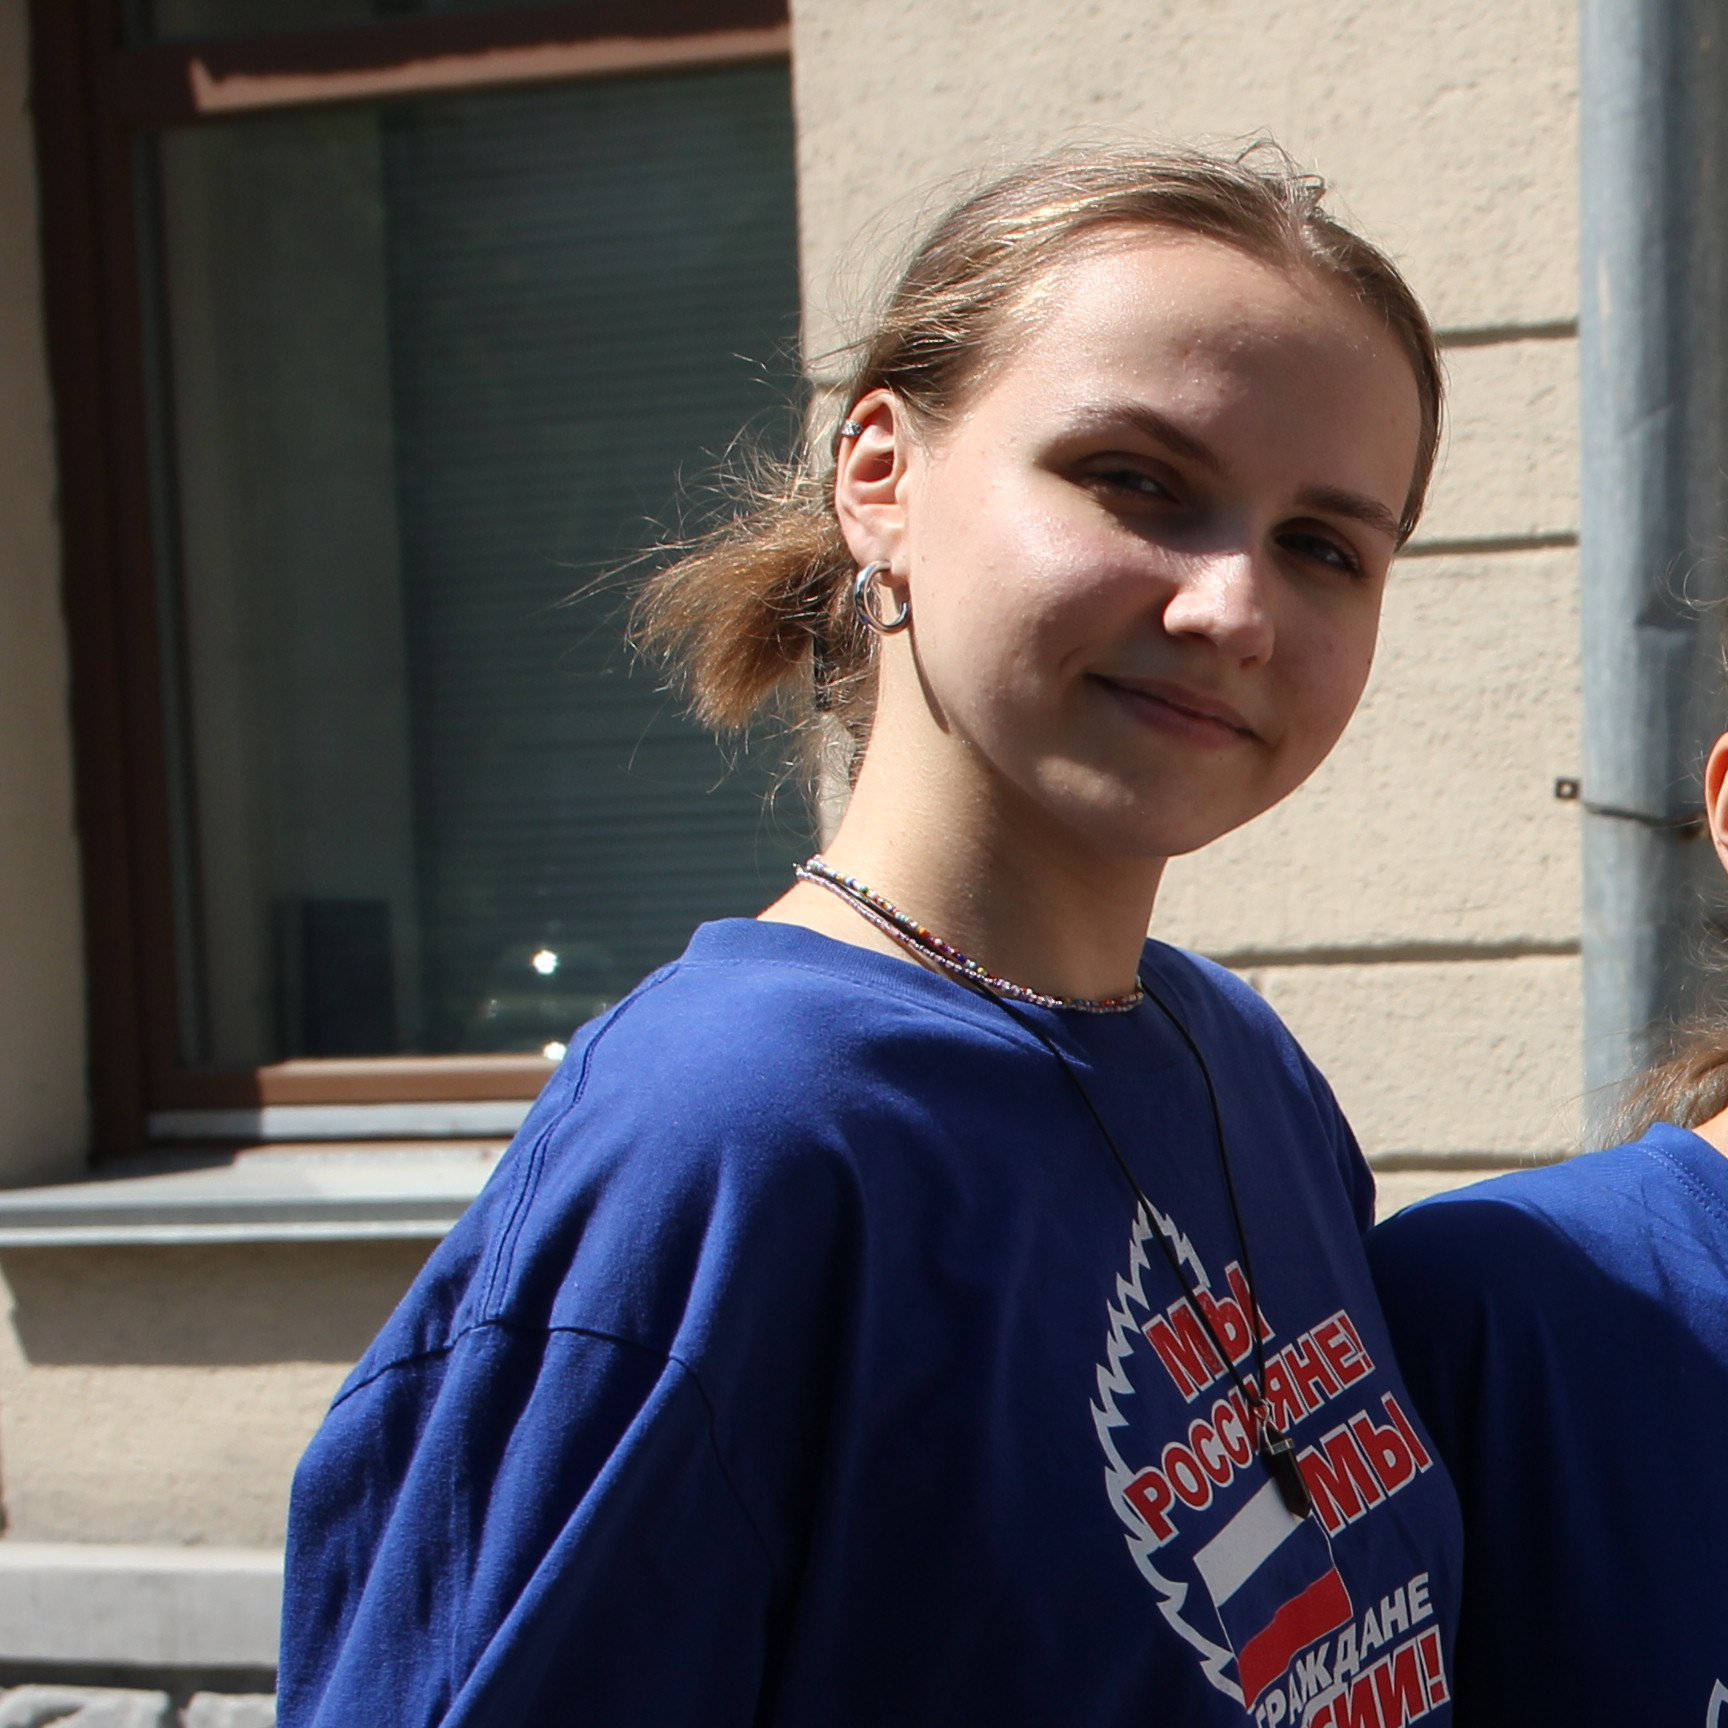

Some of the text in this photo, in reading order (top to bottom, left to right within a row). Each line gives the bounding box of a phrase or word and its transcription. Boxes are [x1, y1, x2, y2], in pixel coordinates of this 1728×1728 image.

[1140, 1261, 1276, 1403] МЫ
[1123, 1309, 1376, 1547] РОССИЯНЕ!
[1296, 1391, 1434, 1538] МЫ
